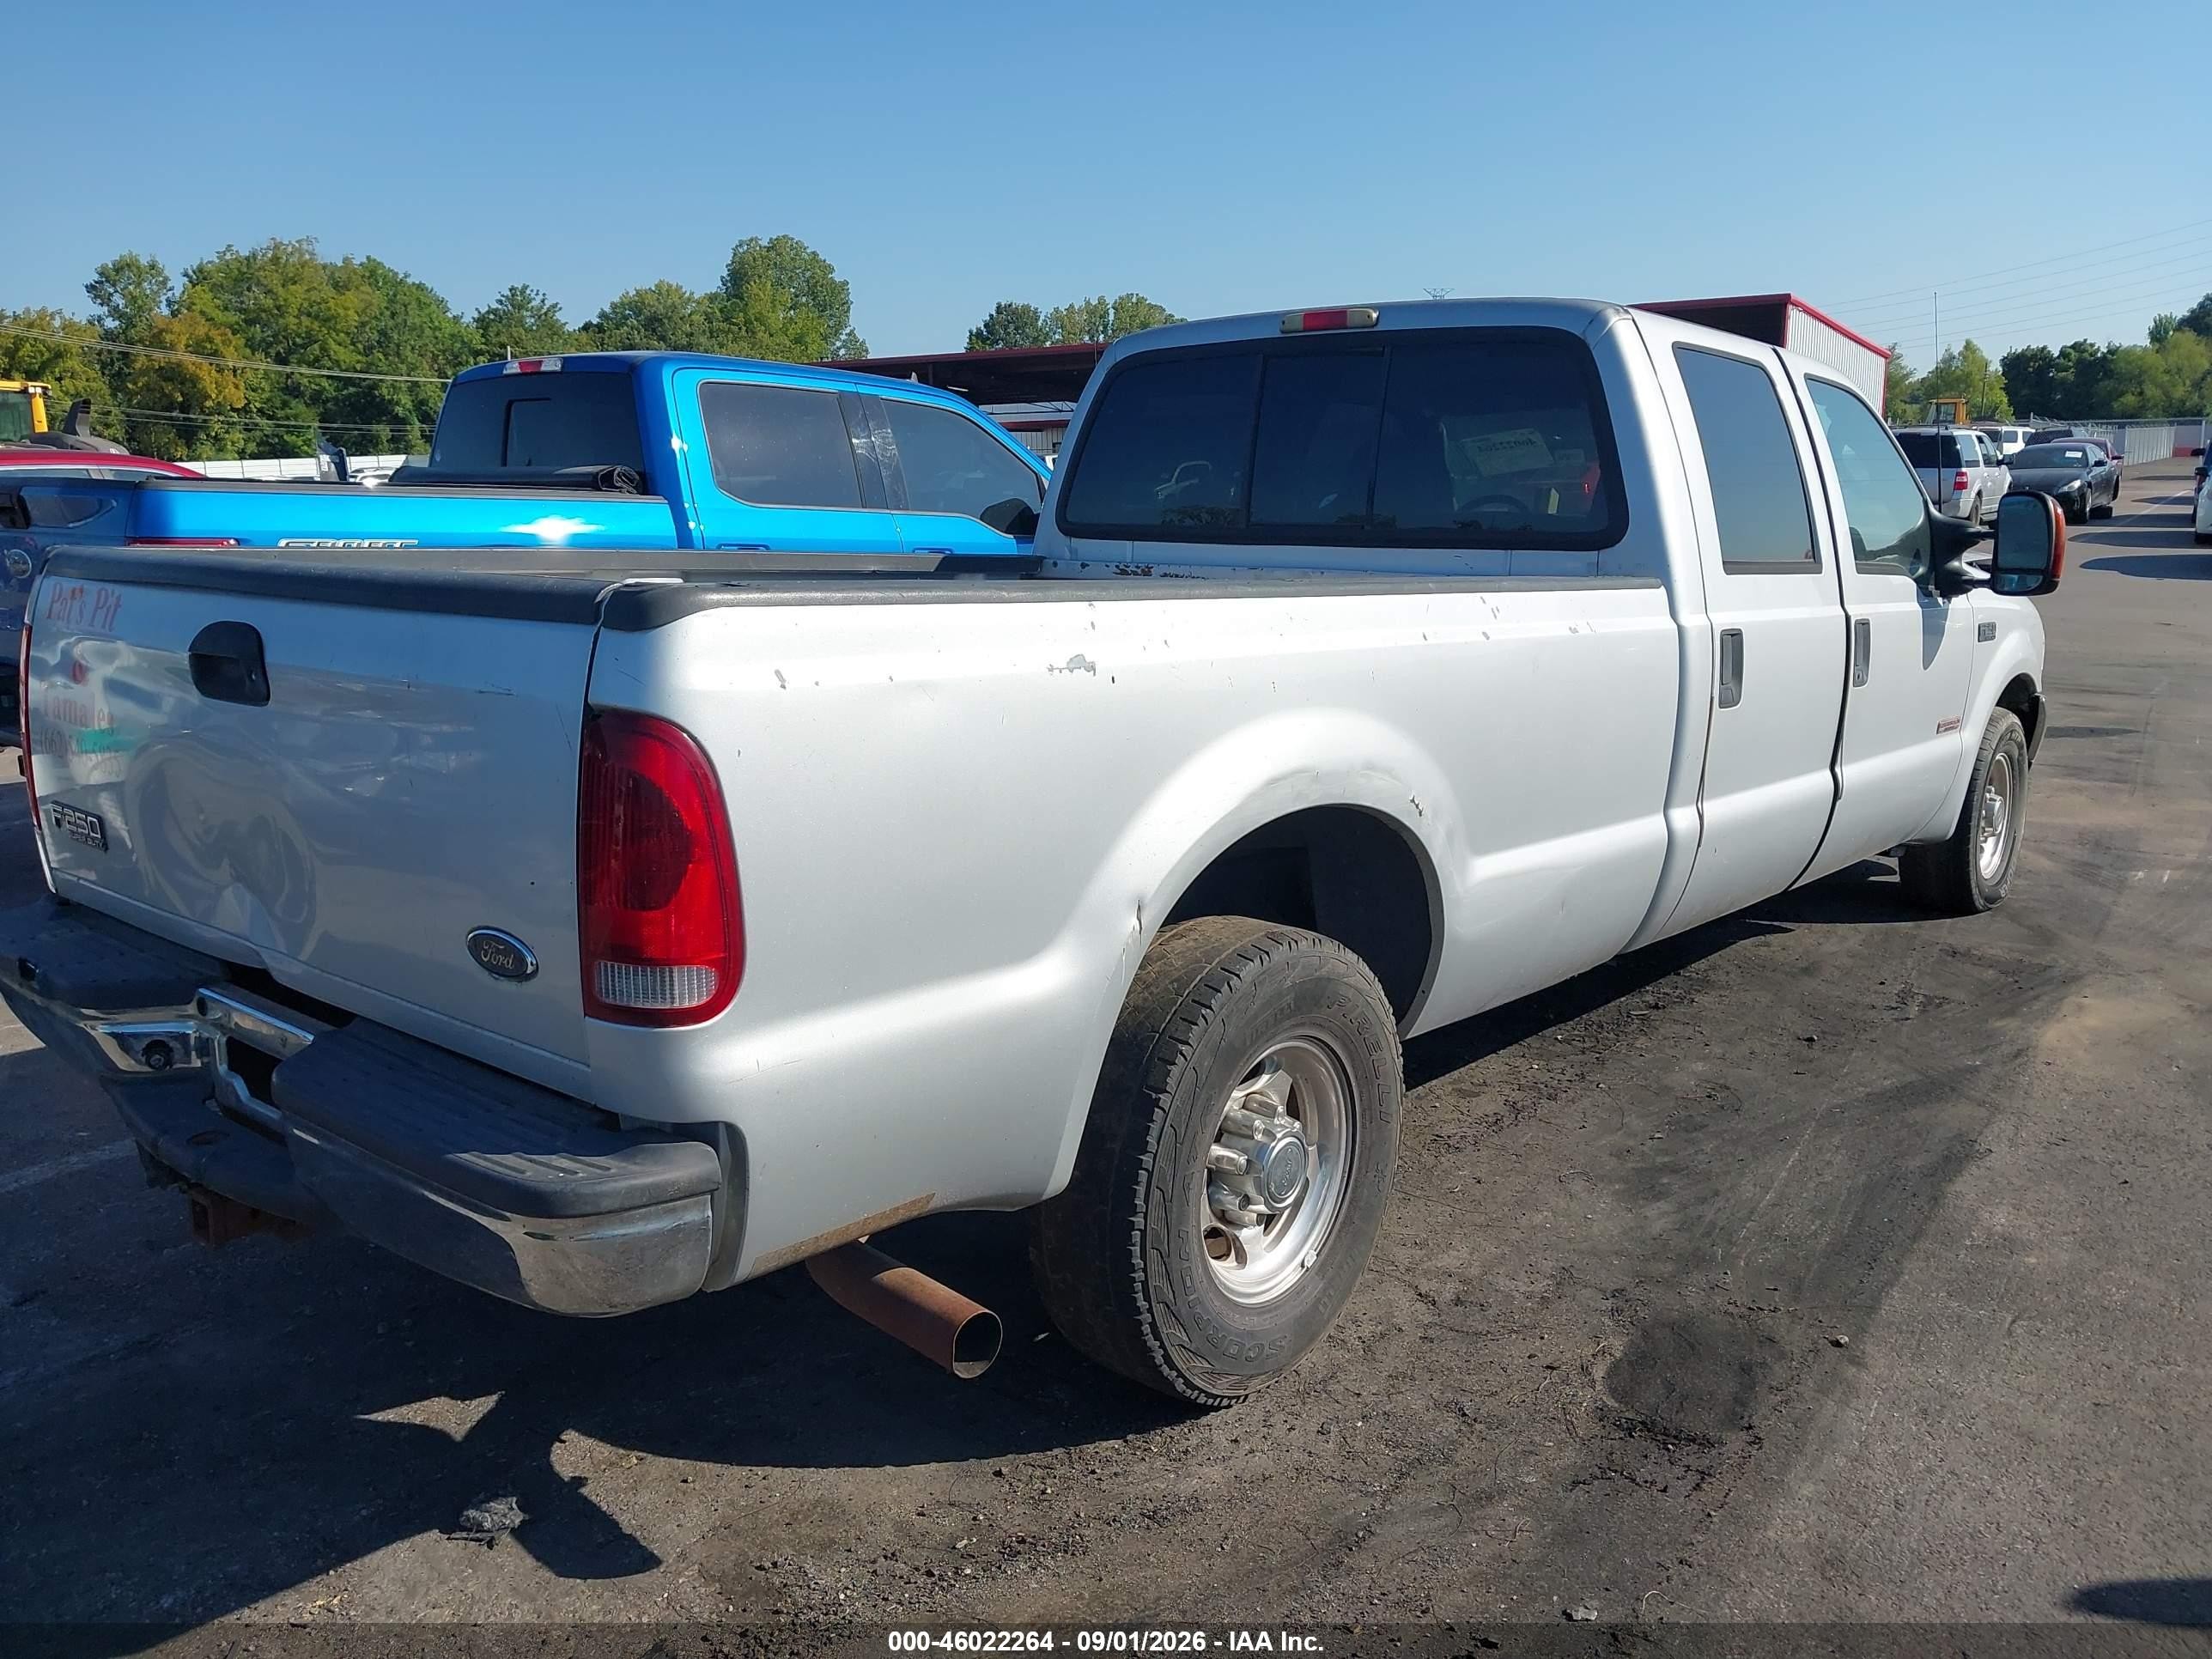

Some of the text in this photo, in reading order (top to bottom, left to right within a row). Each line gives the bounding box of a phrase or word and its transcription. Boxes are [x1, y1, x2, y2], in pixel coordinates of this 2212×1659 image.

[481, 939, 515, 969] Ford
[1326, 992, 1392, 1126] PIRELLI
[1176, 1227, 1290, 1364] SCORPION
